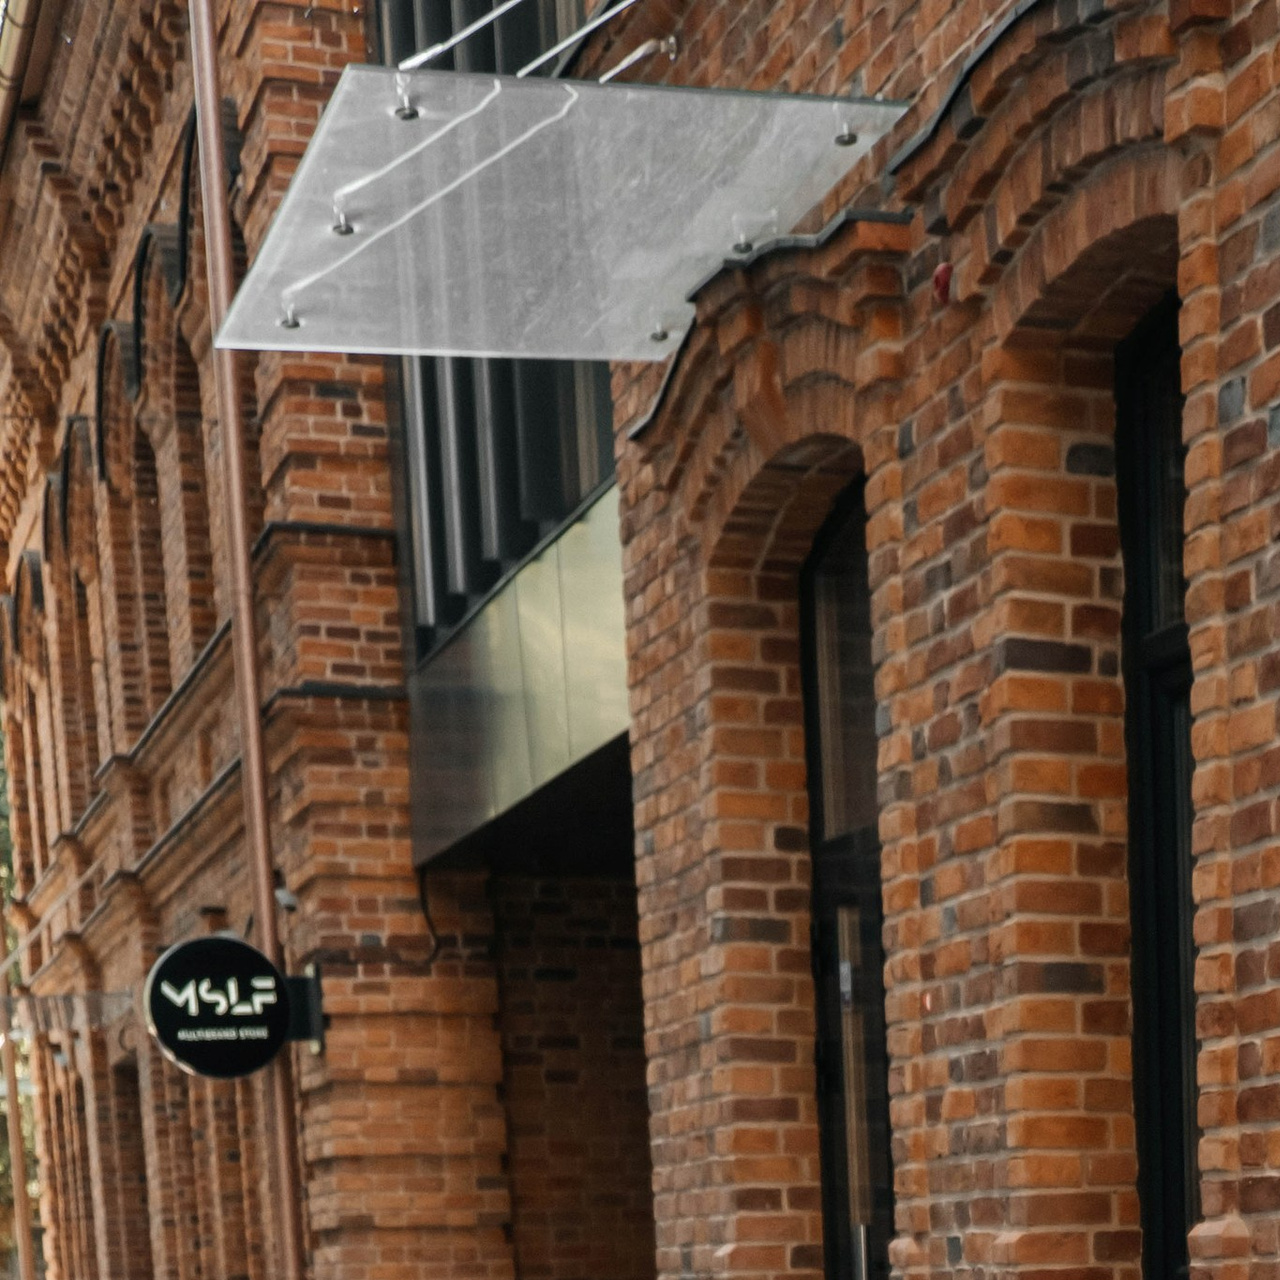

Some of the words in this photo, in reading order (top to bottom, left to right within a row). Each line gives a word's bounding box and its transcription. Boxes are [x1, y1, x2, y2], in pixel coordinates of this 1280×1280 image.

[160, 976, 277, 1017] MSLF
[177, 1028, 238, 1041] MULTIBRAND
[239, 1026, 269, 1040] STORE
